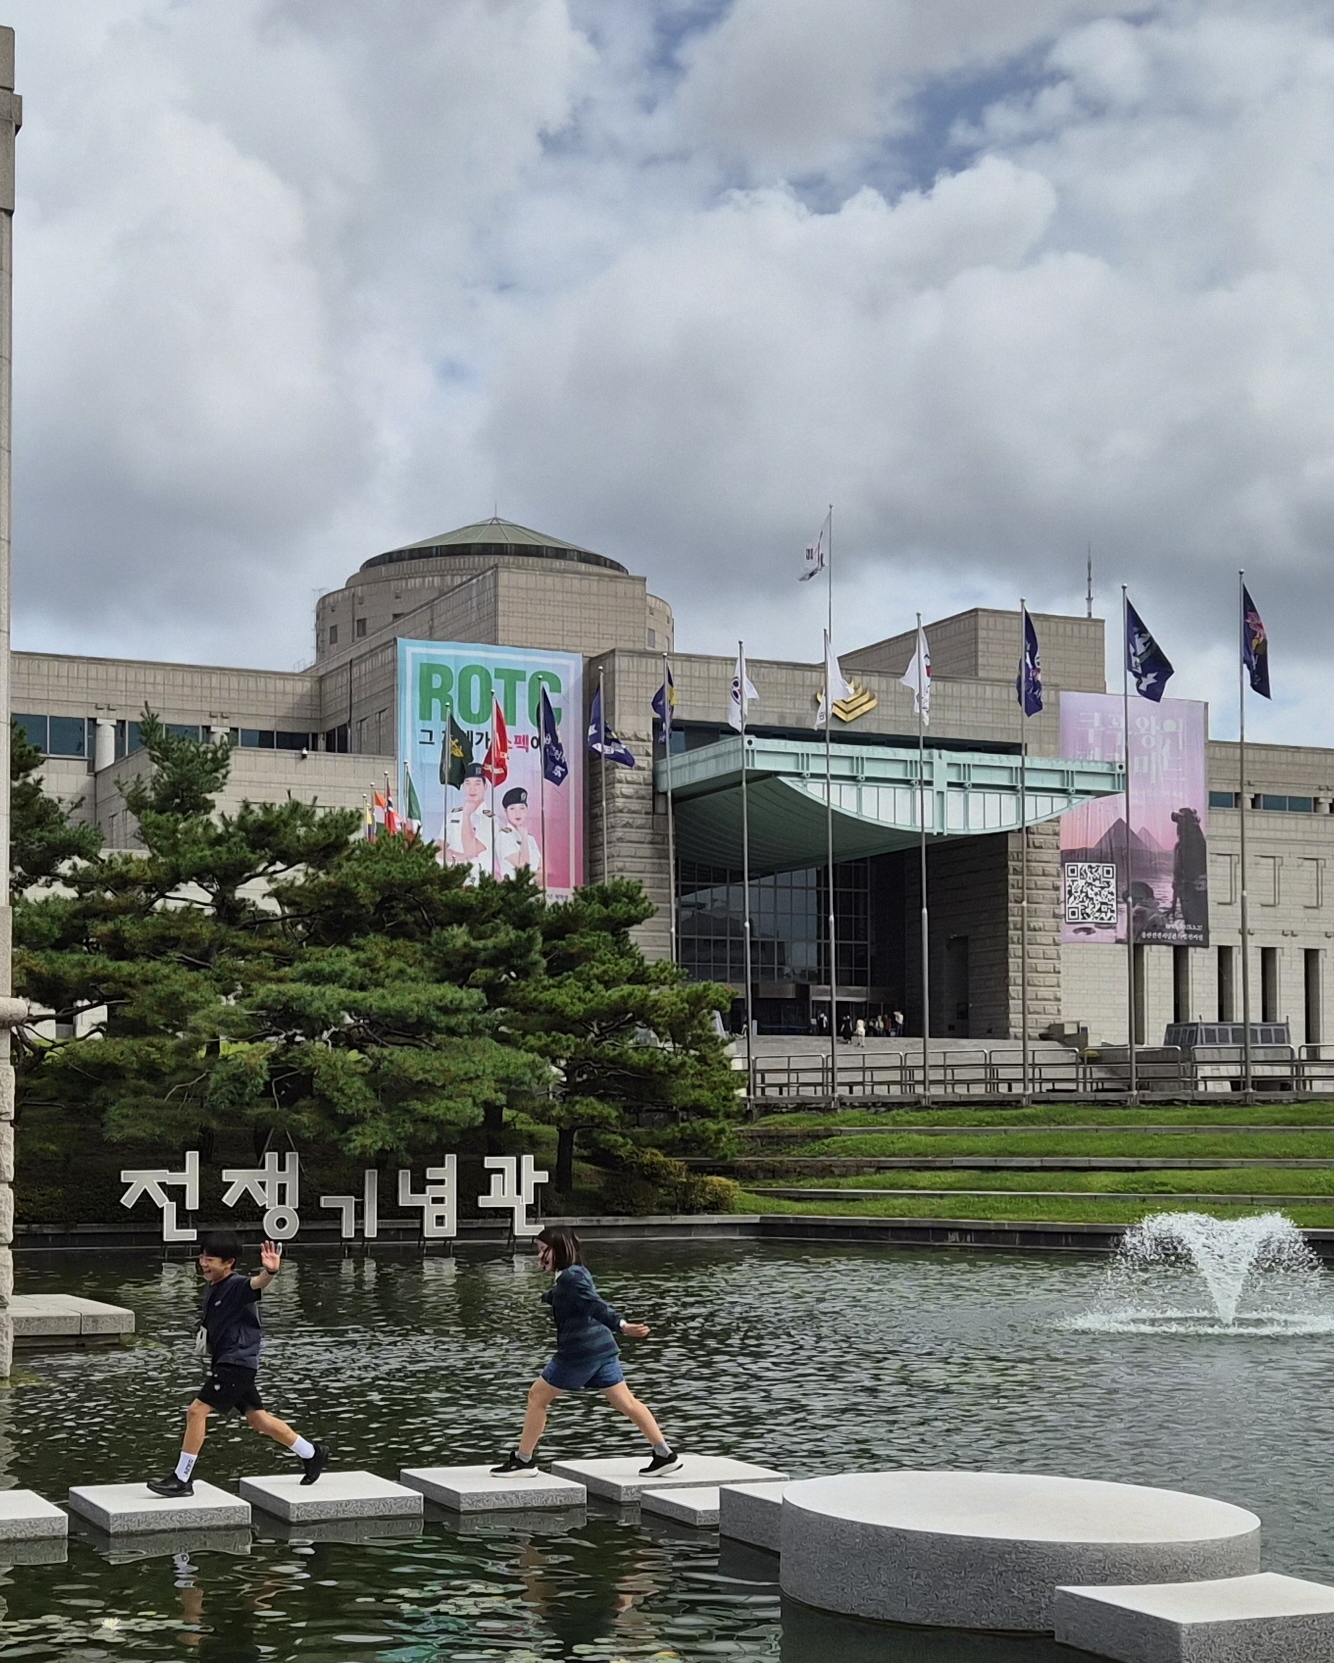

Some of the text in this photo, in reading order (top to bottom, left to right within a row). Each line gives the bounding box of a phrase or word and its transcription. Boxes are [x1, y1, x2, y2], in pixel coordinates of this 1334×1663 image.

[418, 662, 562, 728] ROTC
[419, 728, 436, 746] 그
[120, 1150, 549, 1242] 전쟁기념관
